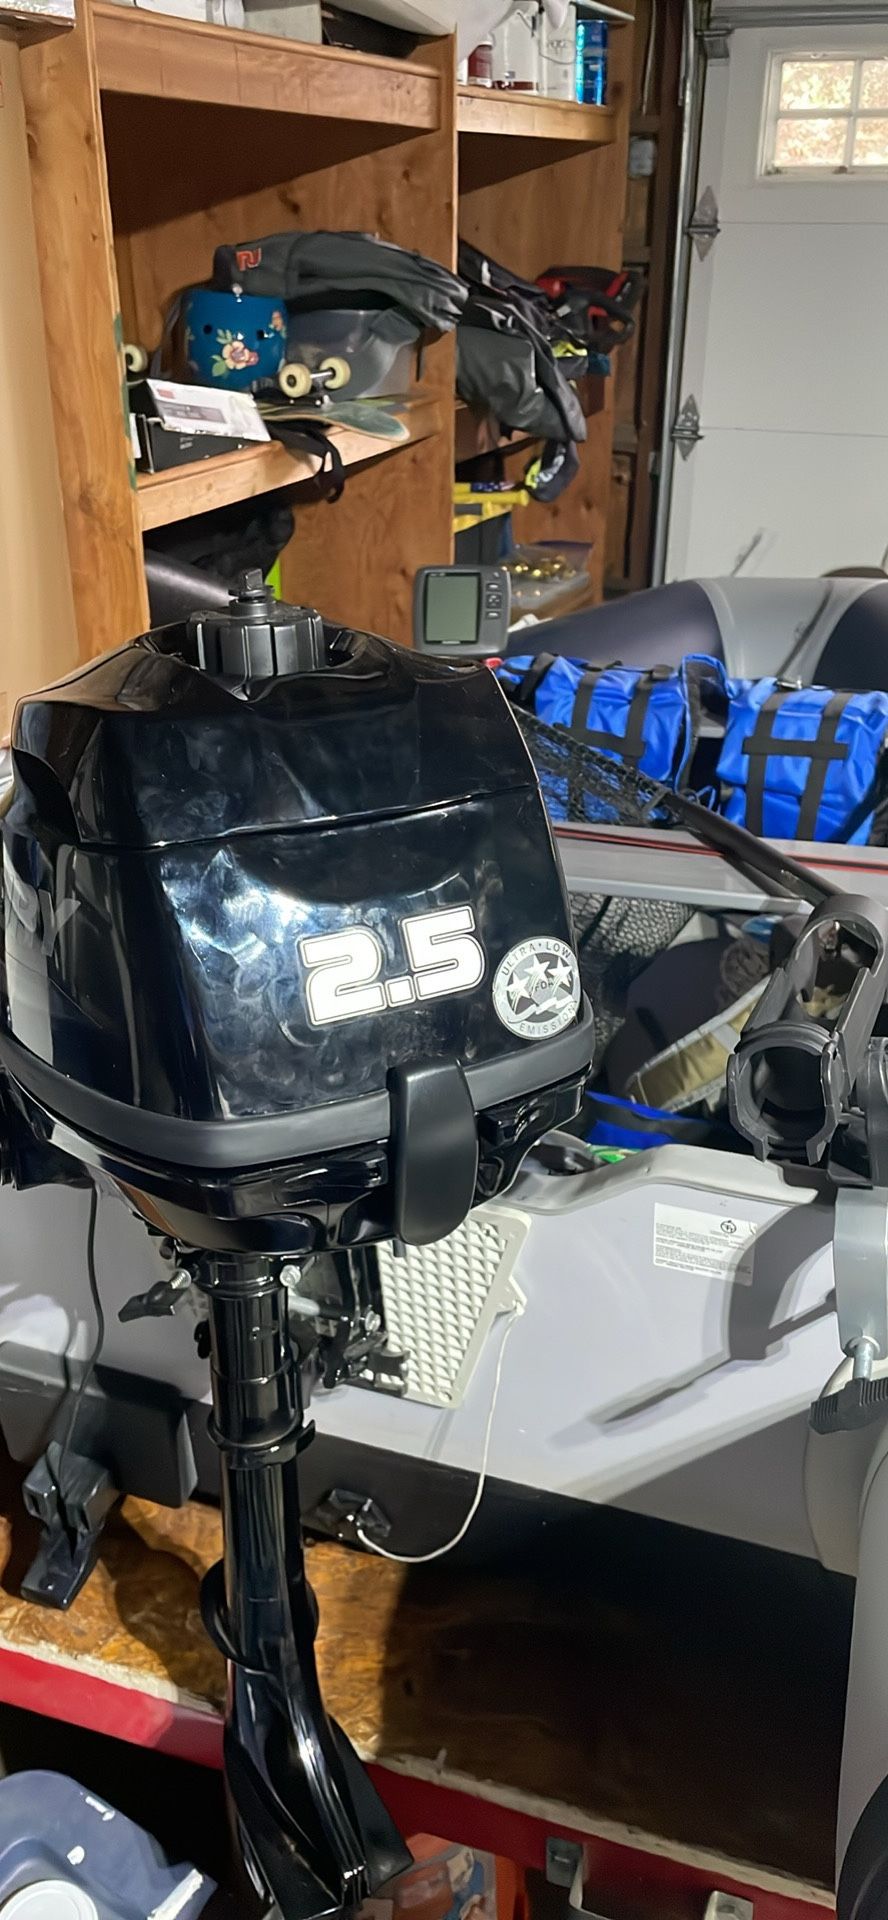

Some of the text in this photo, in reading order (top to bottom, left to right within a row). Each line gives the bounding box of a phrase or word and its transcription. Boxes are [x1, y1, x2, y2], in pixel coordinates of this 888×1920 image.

[299, 904, 486, 1026] 2.5
[502, 941, 571, 976] ULTRA LOW
[519, 1003, 577, 1035] EMISSION
